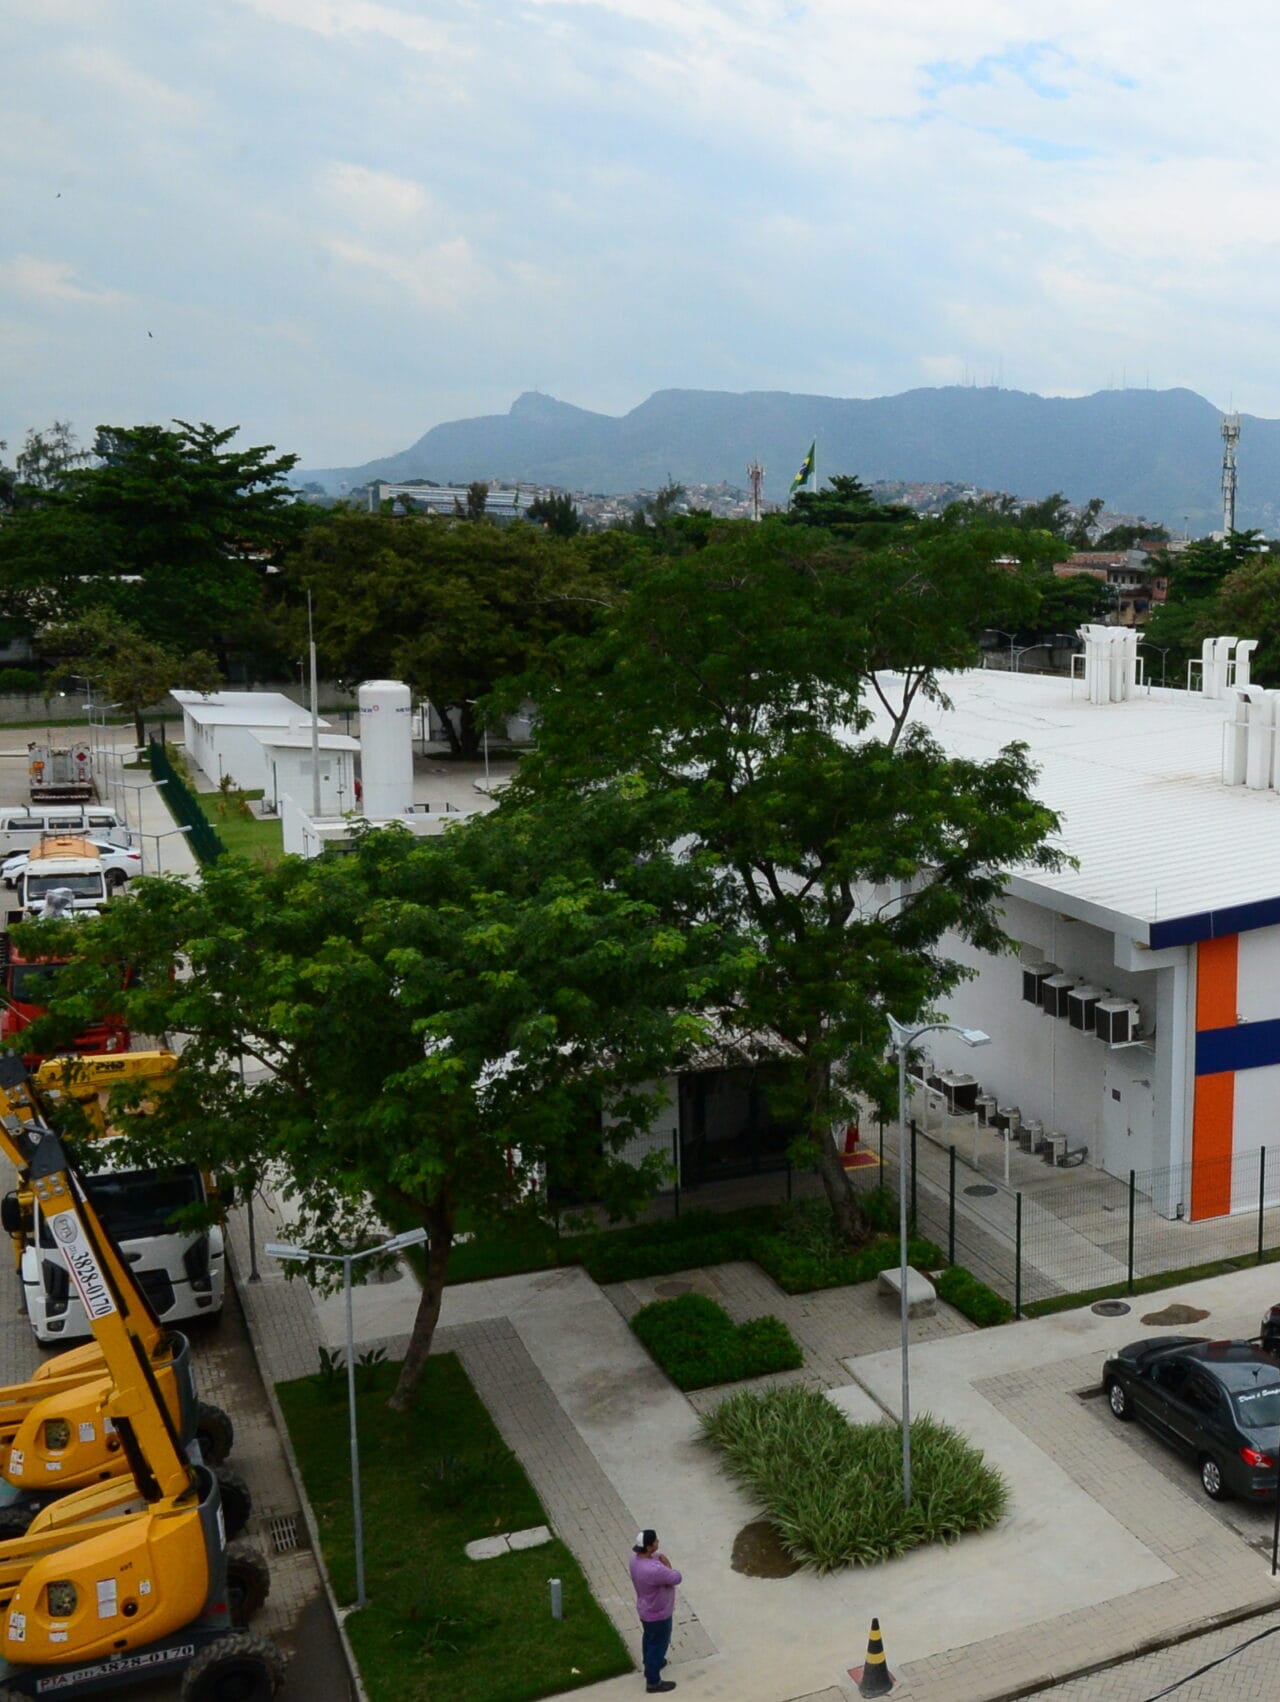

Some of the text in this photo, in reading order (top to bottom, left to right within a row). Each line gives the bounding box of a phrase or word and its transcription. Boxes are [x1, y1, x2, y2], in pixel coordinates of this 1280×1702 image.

[59, 1218, 73, 1239] PTA
[71, 1251, 113, 1316] 3828-0170
[40, 1675, 68, 1688] PTA
[100, 1646, 192, 1671] 3828-0170
